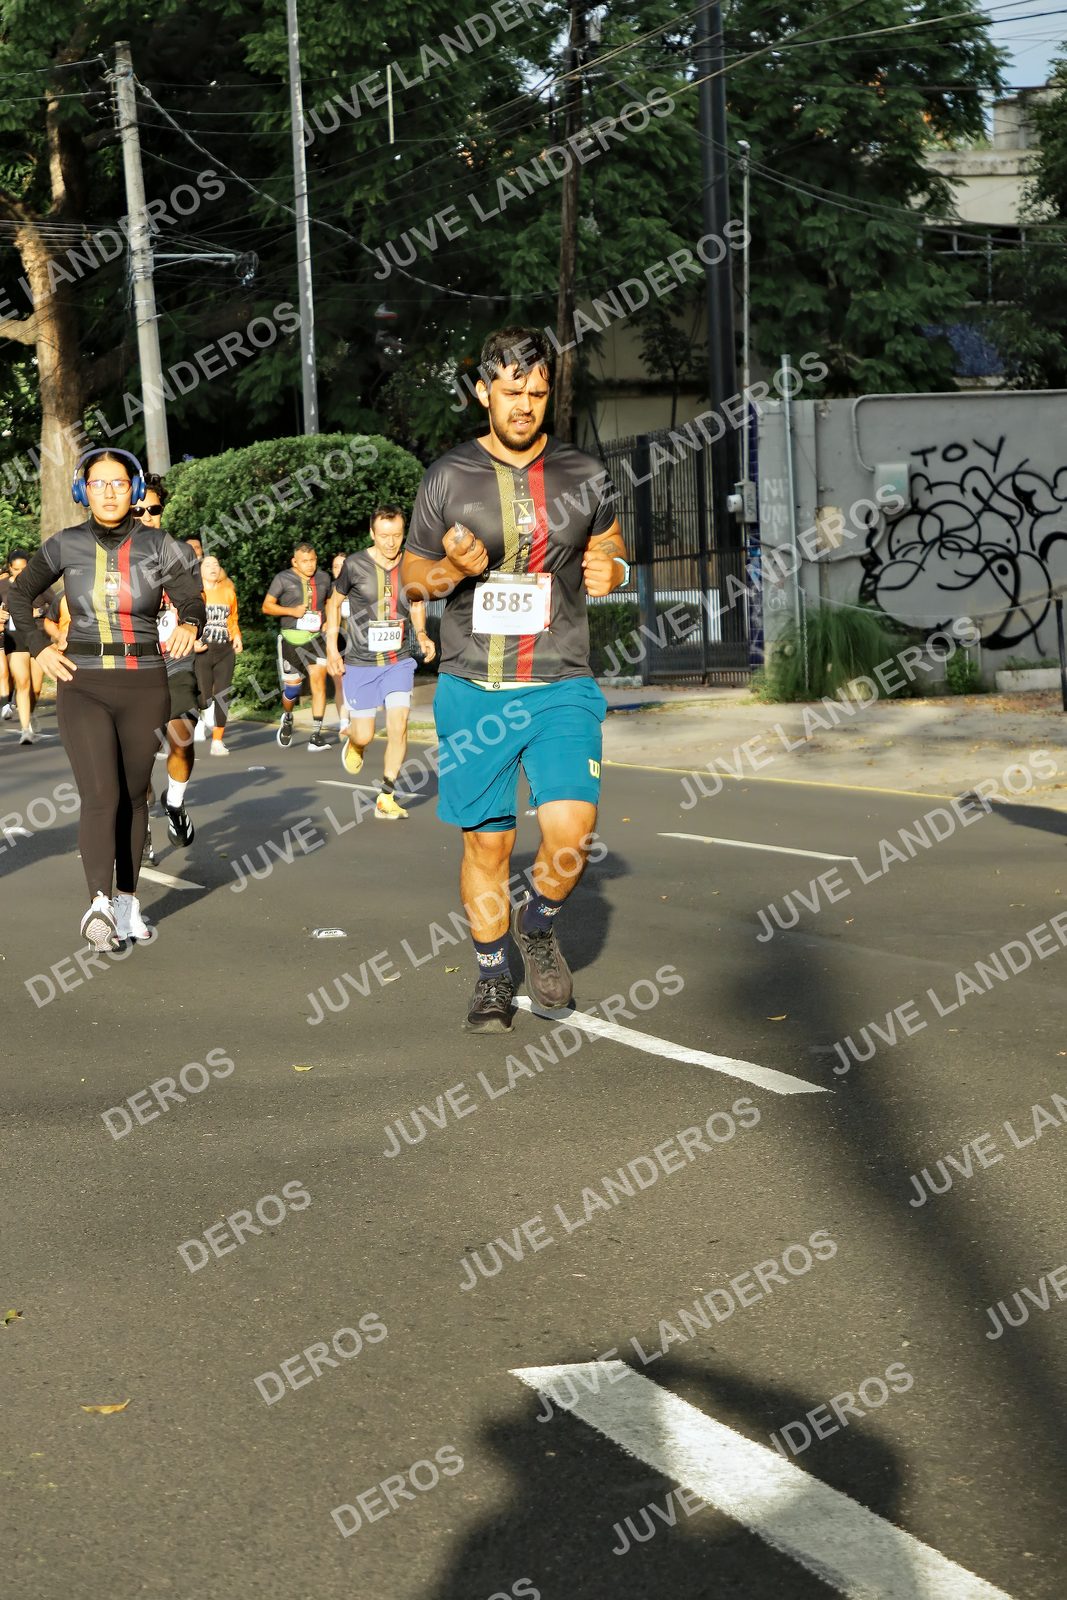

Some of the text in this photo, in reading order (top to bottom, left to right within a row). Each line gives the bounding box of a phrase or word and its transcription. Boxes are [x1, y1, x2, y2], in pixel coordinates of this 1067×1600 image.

[911, 434, 1005, 472] TOY
[482, 591, 532, 612] 8585
[371, 631, 401, 642] 12280
